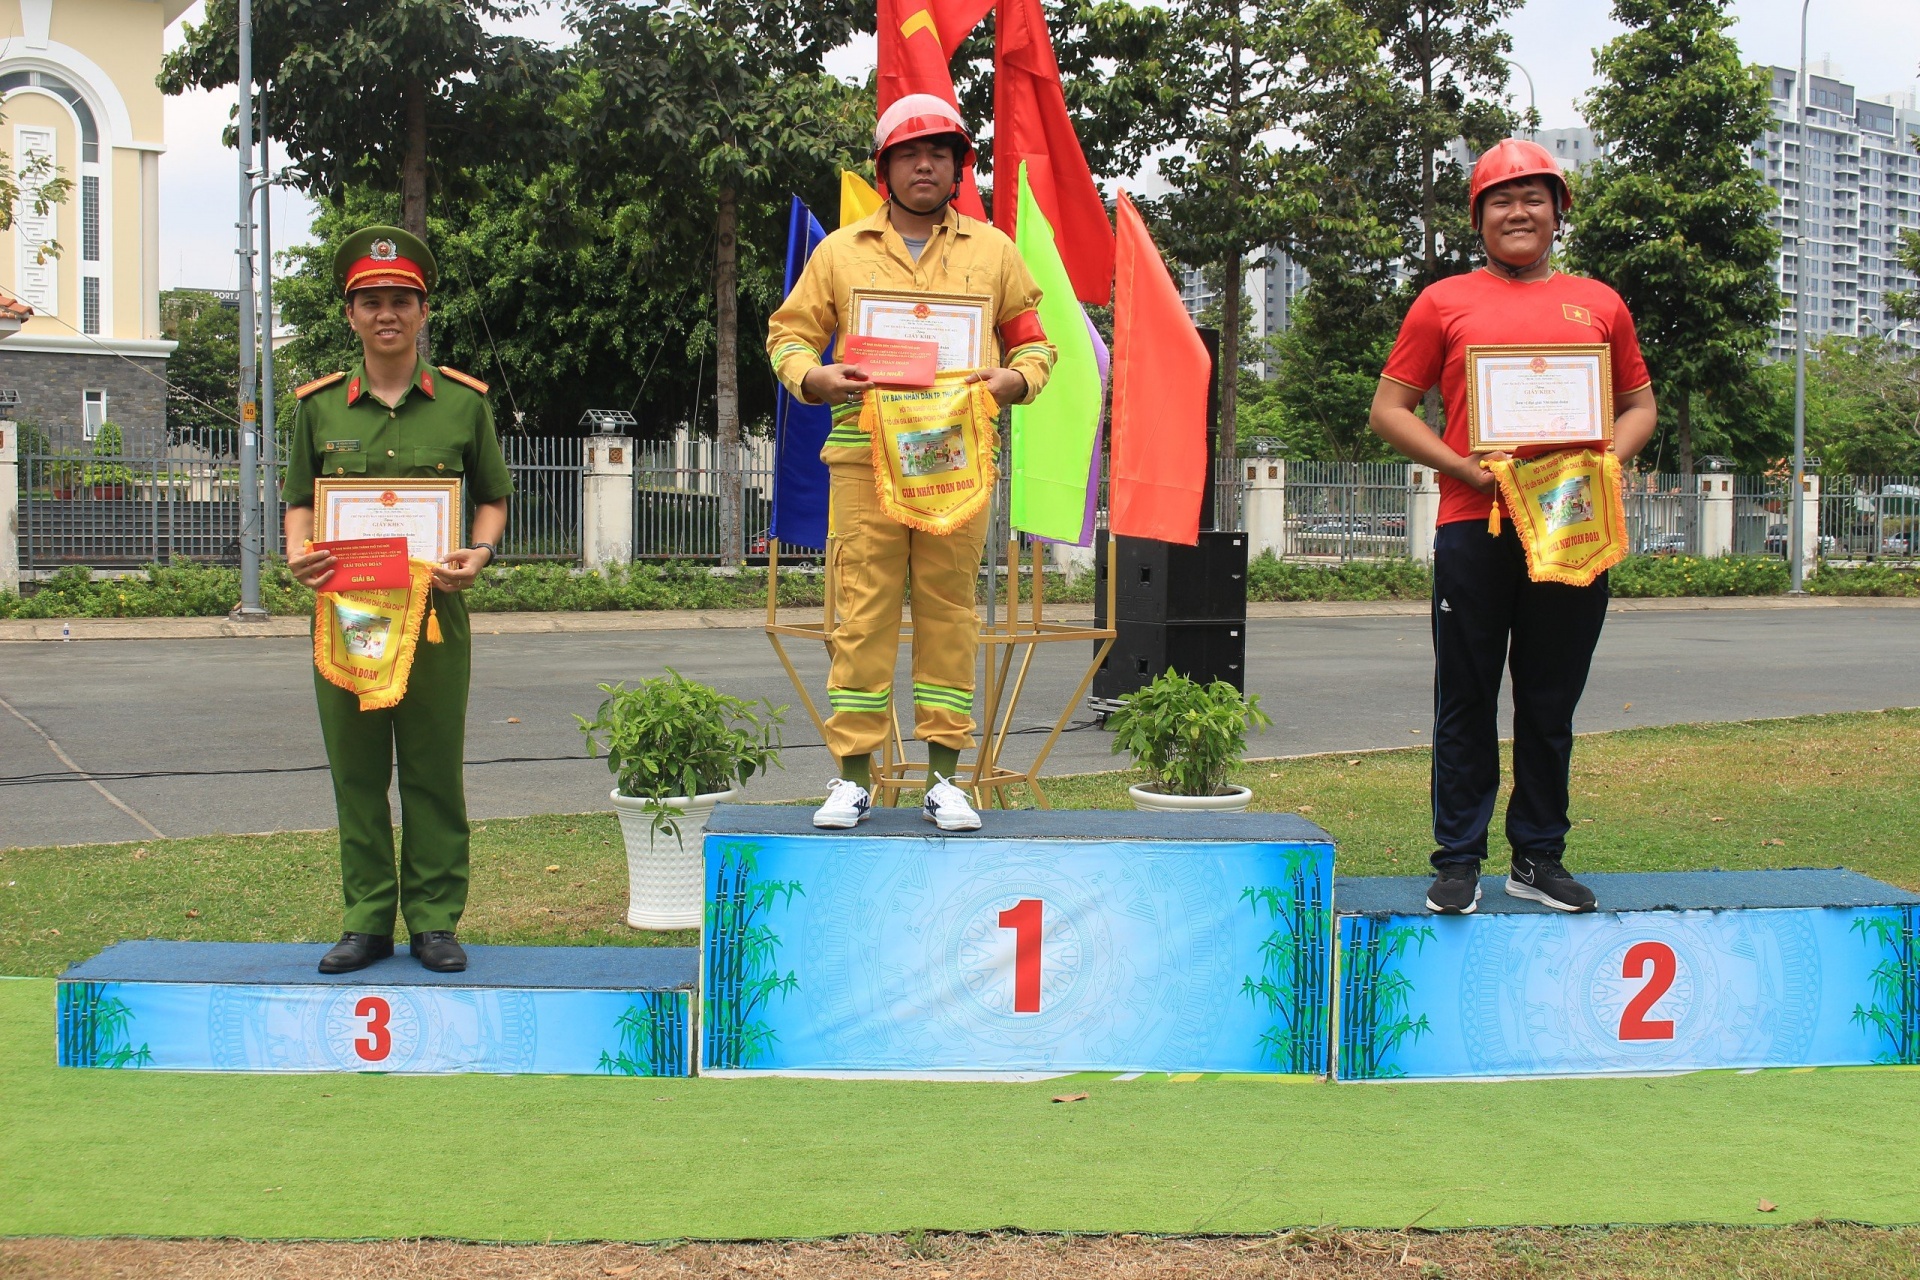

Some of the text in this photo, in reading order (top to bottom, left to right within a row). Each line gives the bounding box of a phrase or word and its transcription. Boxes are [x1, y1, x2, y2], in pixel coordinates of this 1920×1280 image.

[214, 292, 233, 300] PORT
[904, 391, 919, 400] NHÂN
[921, 390, 933, 400] DÂN
[902, 478, 975, 498] GIẢI NHẤT TOÀN ĐOÀN
[1571, 532, 1584, 546] TOÀN
[352, 574, 364, 582] GIẢI
[359, 668, 378, 681] ĐOÀN
[999, 900, 1042, 1012] 1
[1618, 942, 1676, 1040] 2
[354, 996, 391, 1061] 3
